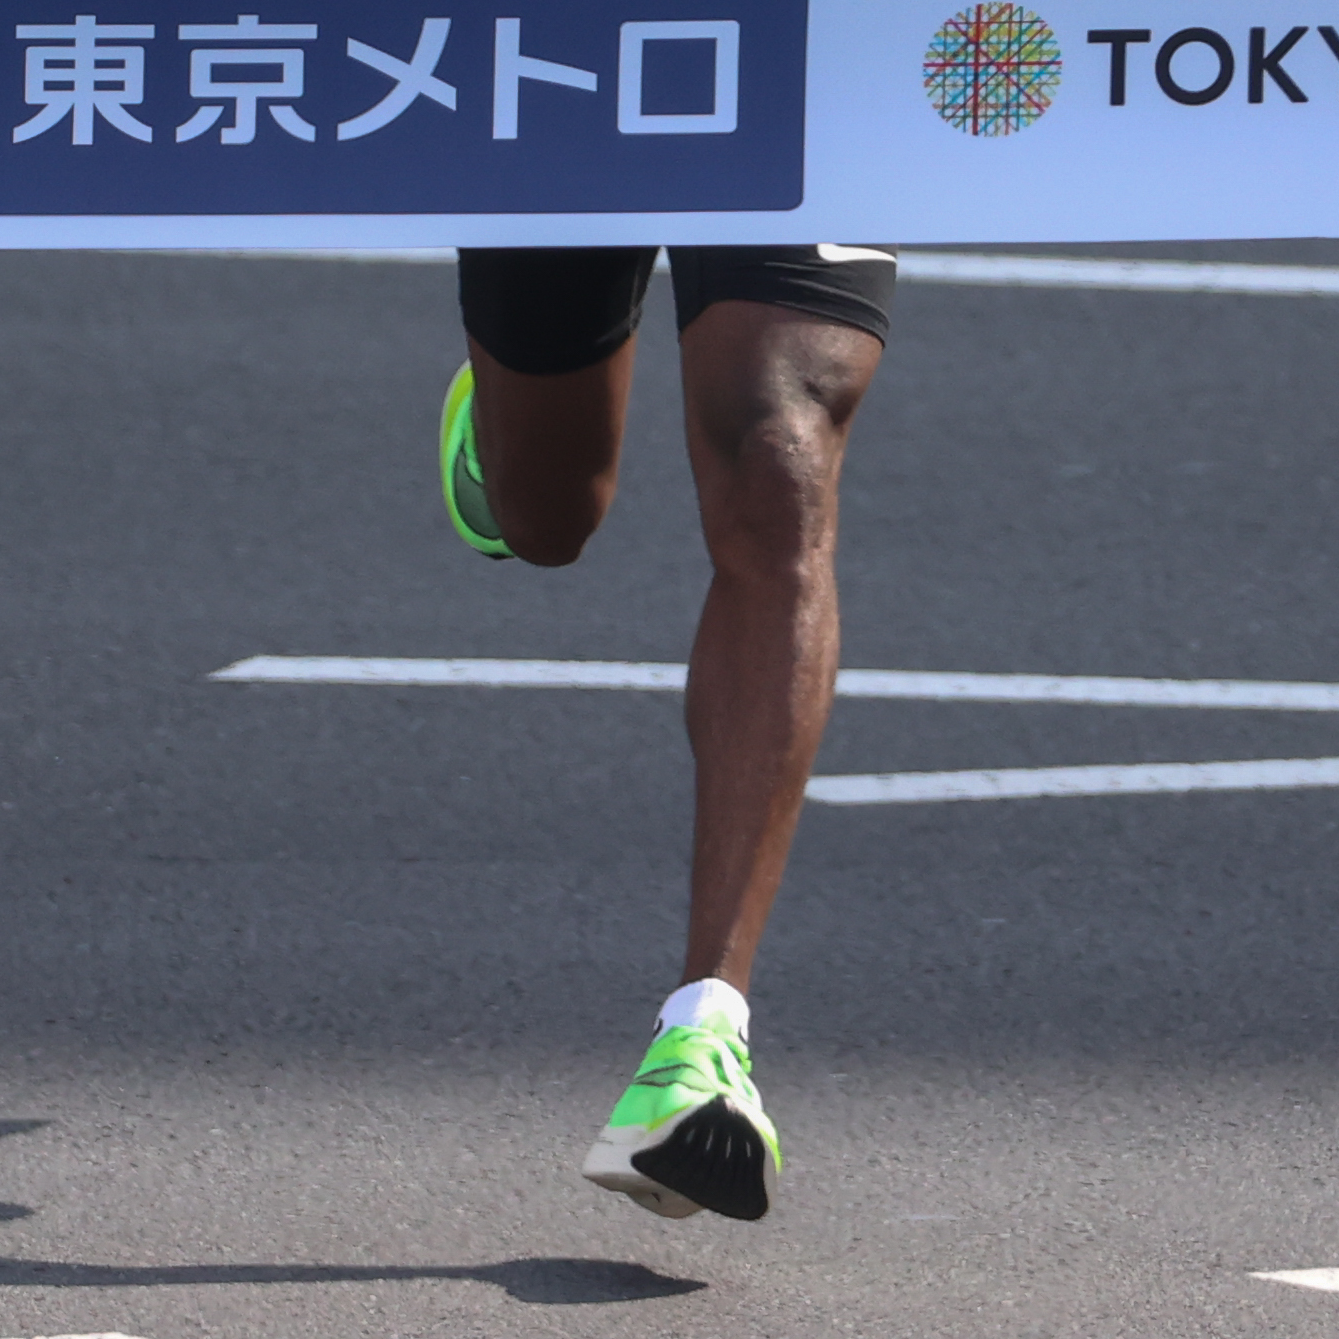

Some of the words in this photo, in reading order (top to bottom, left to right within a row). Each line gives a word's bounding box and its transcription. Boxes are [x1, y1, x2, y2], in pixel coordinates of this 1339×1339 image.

[12, 14, 742, 147] 東京メトロ
